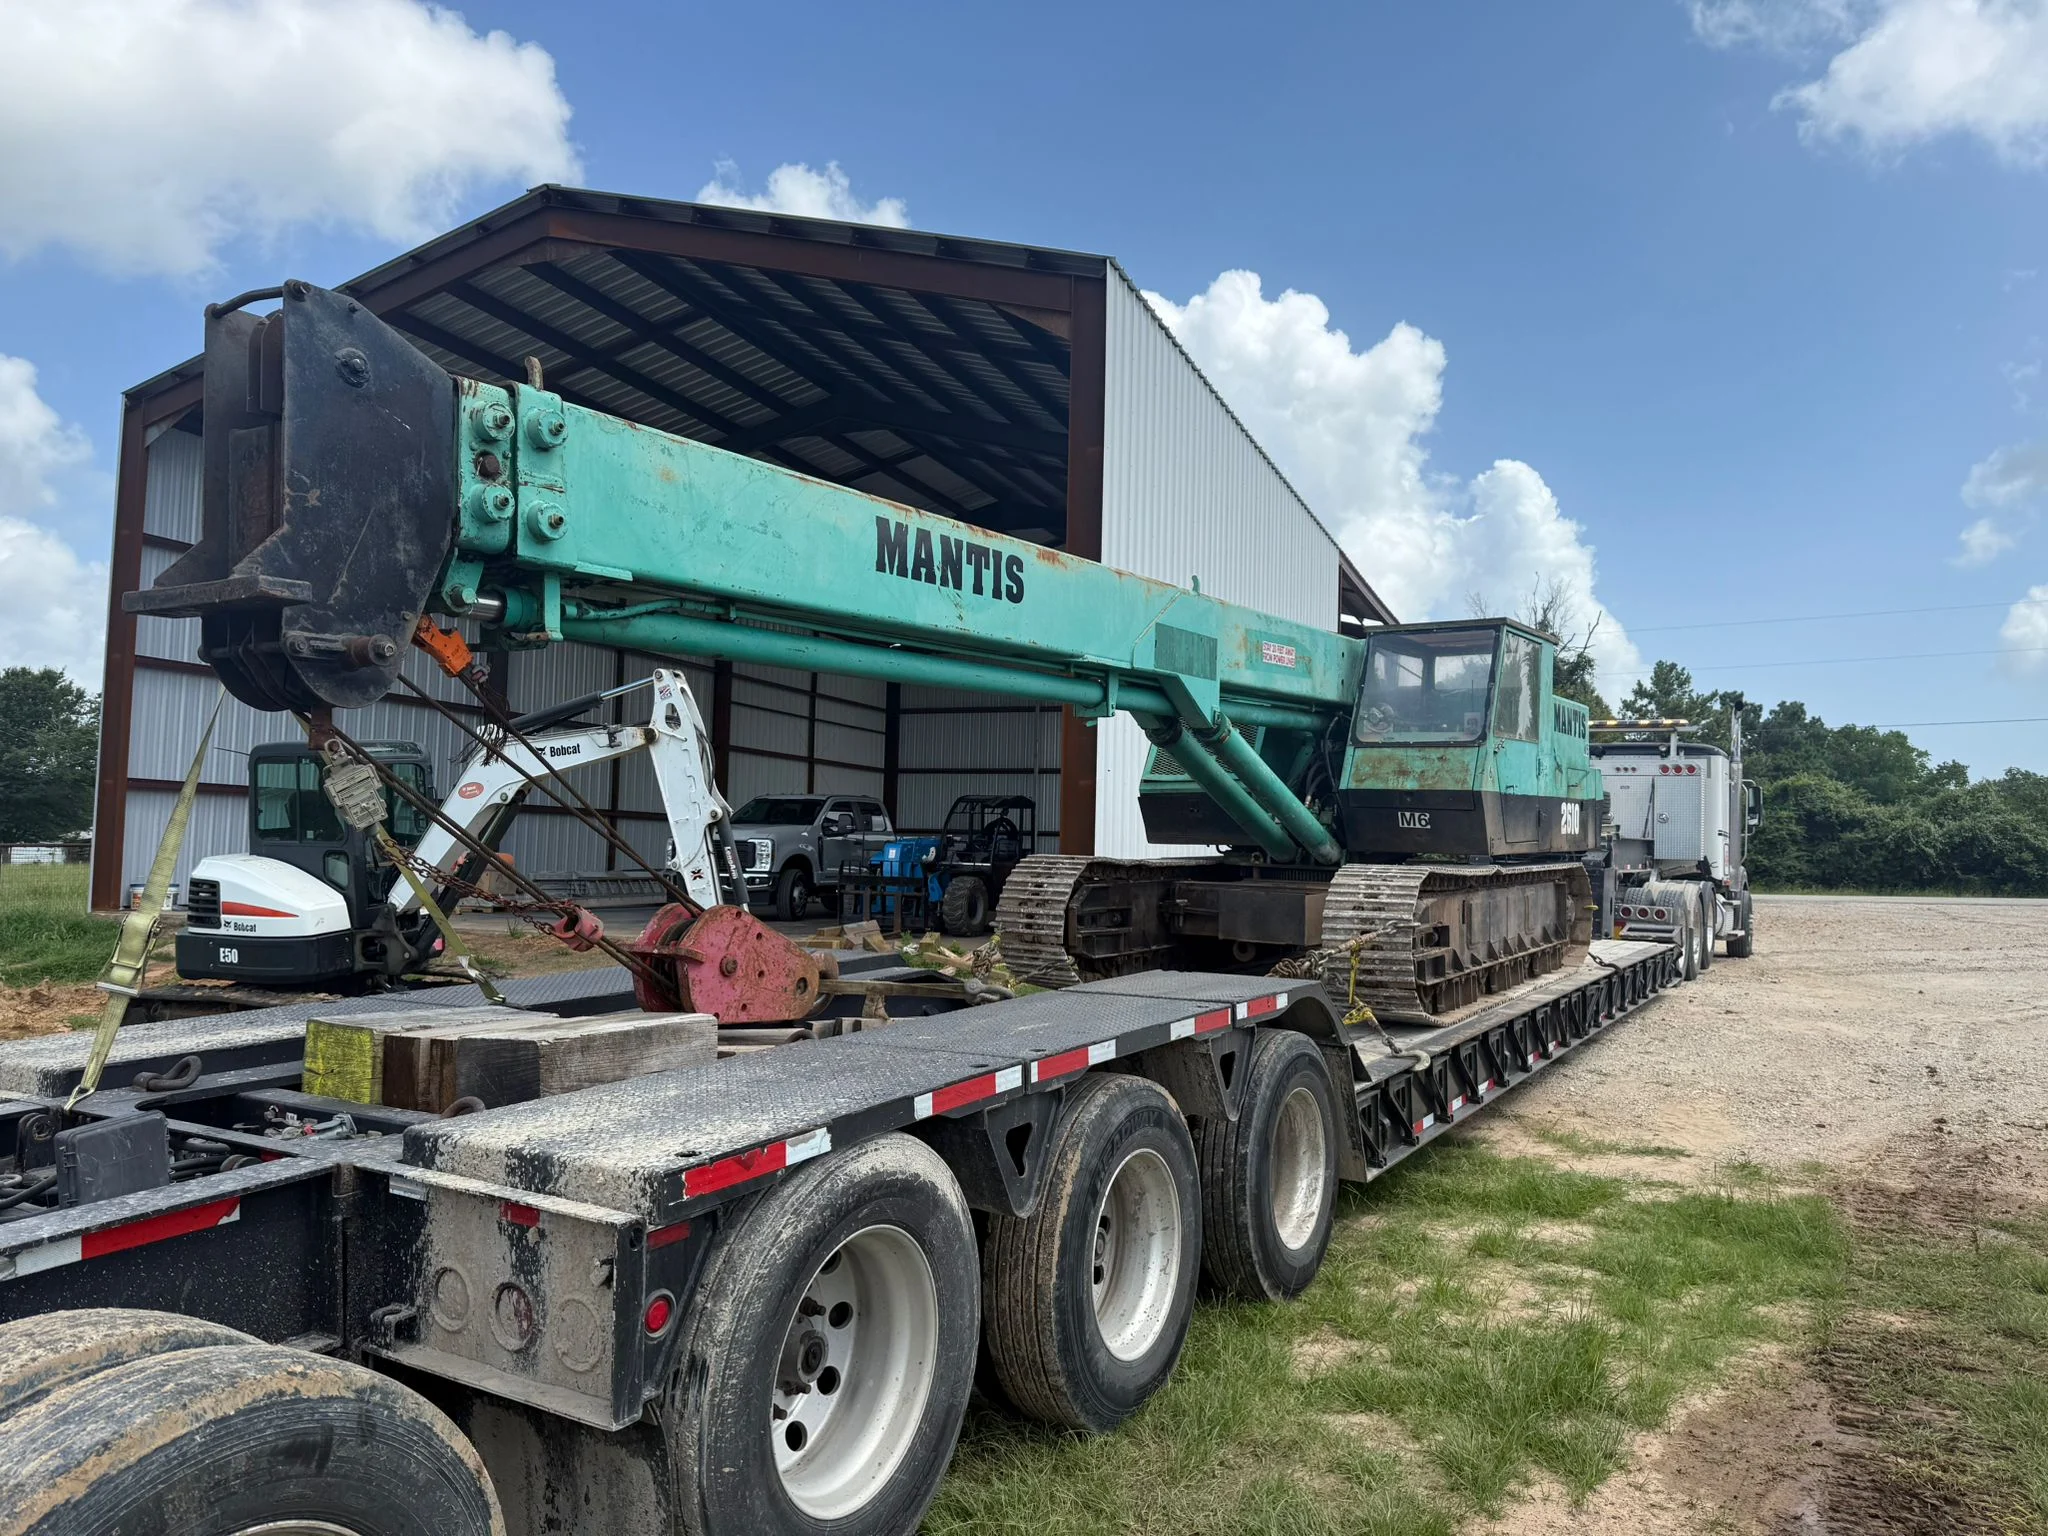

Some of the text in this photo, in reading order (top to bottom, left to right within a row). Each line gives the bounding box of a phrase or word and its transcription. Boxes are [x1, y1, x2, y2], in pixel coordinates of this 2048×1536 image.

[875, 515, 1025, 604] MANTIS
[1553, 703, 1586, 740] MANTIS
[549, 743, 581, 757] Bobcat
[1400, 812, 1429, 827] M6
[1561, 802, 1580, 835] 2610
[233, 922, 257, 932] Bobcat
[219, 947, 239, 963] E50
